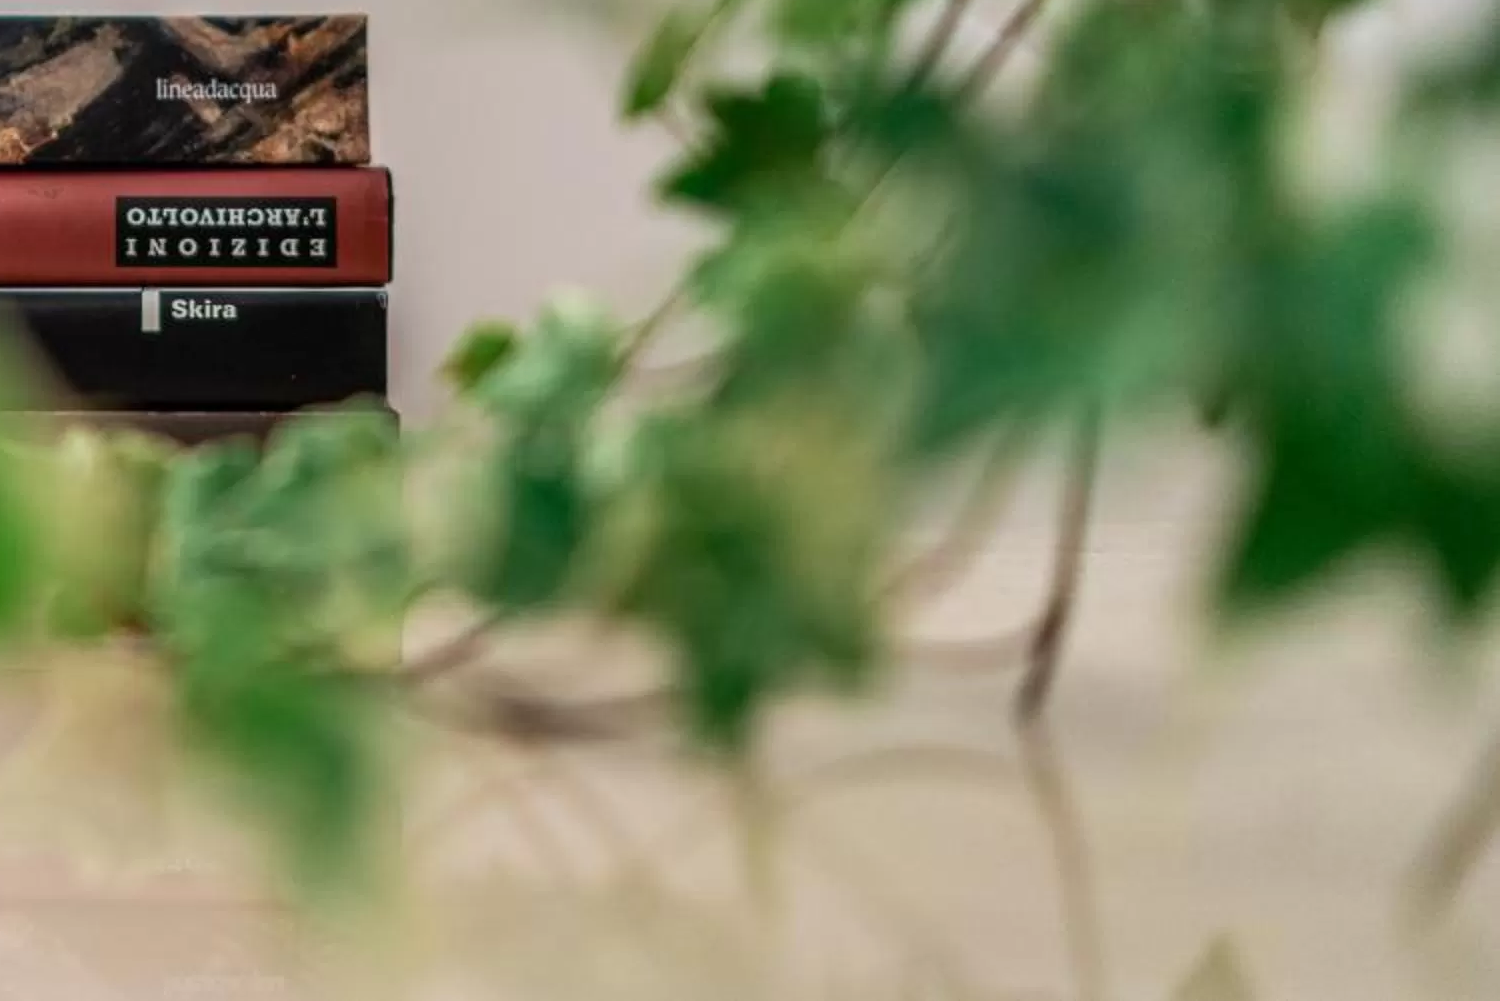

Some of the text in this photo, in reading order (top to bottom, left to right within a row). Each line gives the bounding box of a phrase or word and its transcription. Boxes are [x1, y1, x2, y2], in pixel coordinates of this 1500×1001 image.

[156, 77, 277, 104] lineadacqua
[126, 207, 326, 228] L'ARCHIVOLTO
[126, 238, 326, 257] EDIZIONI
[171, 298, 238, 321] Skira
